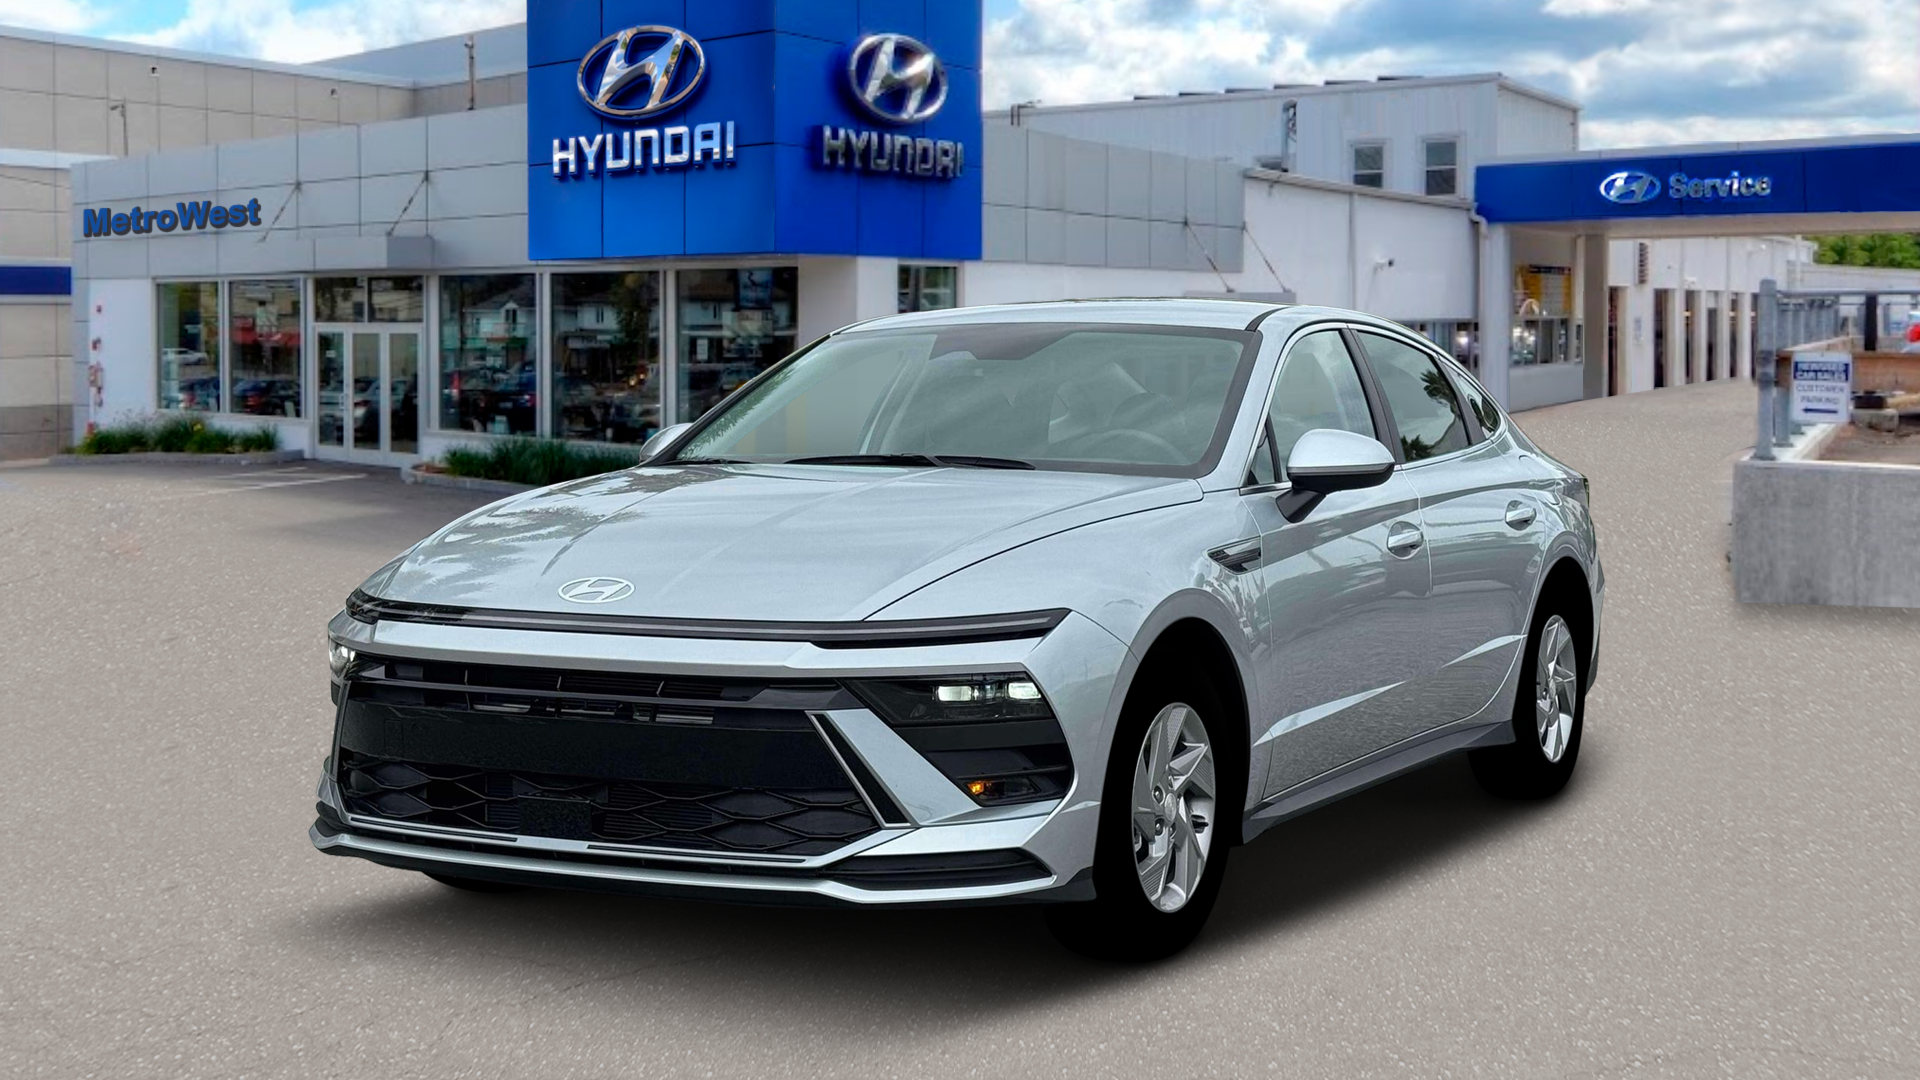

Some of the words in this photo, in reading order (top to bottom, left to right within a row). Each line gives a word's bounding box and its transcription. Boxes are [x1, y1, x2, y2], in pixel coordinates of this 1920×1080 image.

[552, 120, 735, 176] HYUNDAI
[822, 124, 965, 178] HYUNDAI
[1668, 170, 1772, 199] Service
[83, 198, 262, 238] MetroWest
